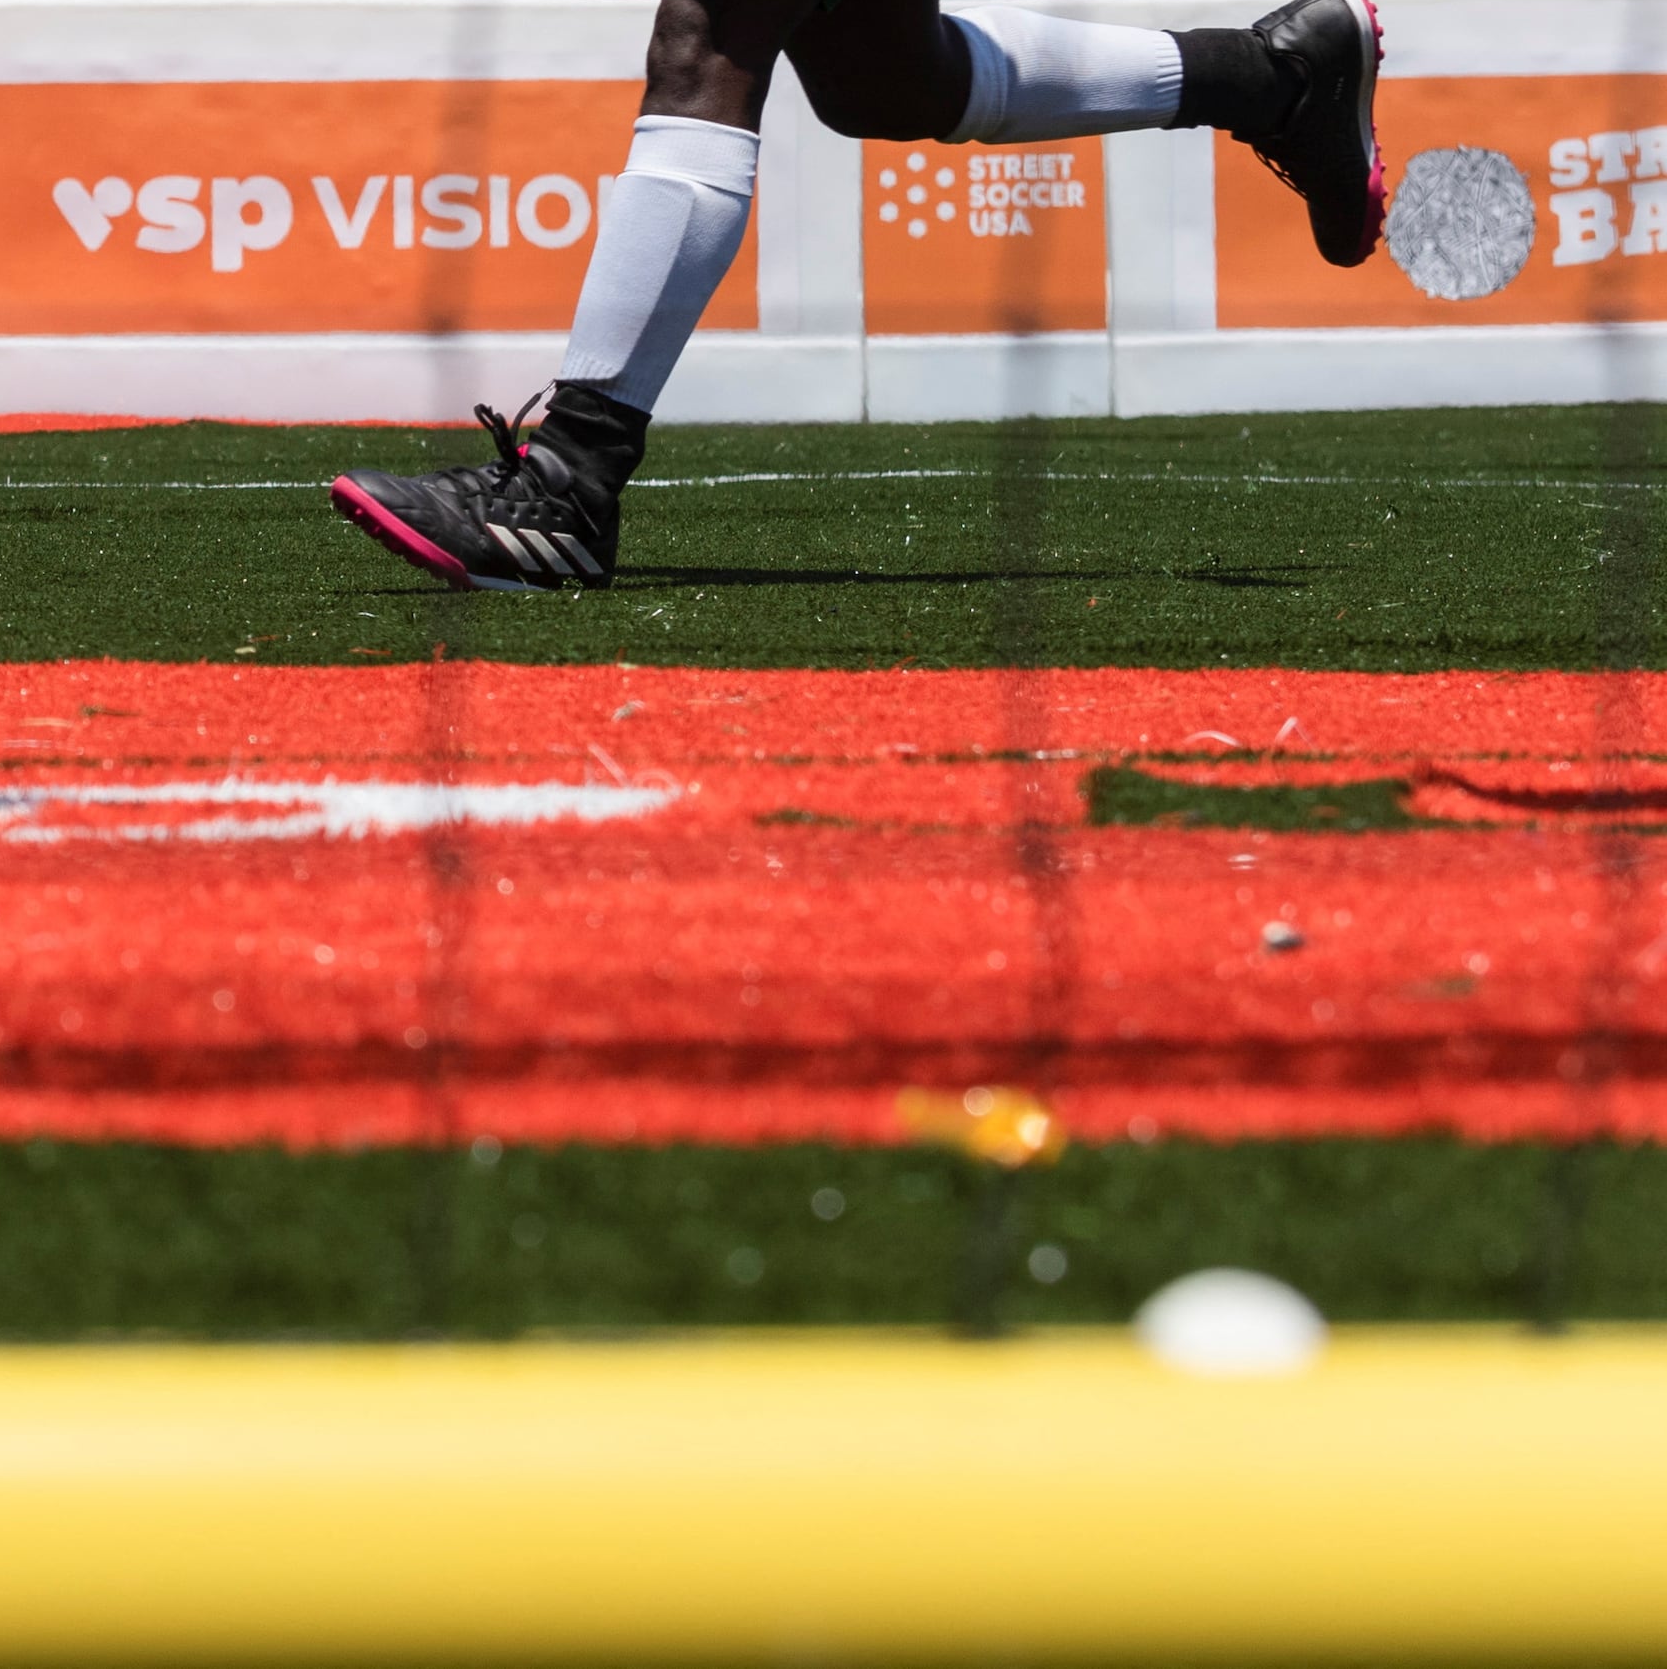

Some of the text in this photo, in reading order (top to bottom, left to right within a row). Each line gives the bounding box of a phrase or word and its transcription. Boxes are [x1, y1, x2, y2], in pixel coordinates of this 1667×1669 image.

[968, 153, 1075, 181] STREET
[968, 181, 1086, 209] SOCCER
[969, 209, 1034, 236] USA
